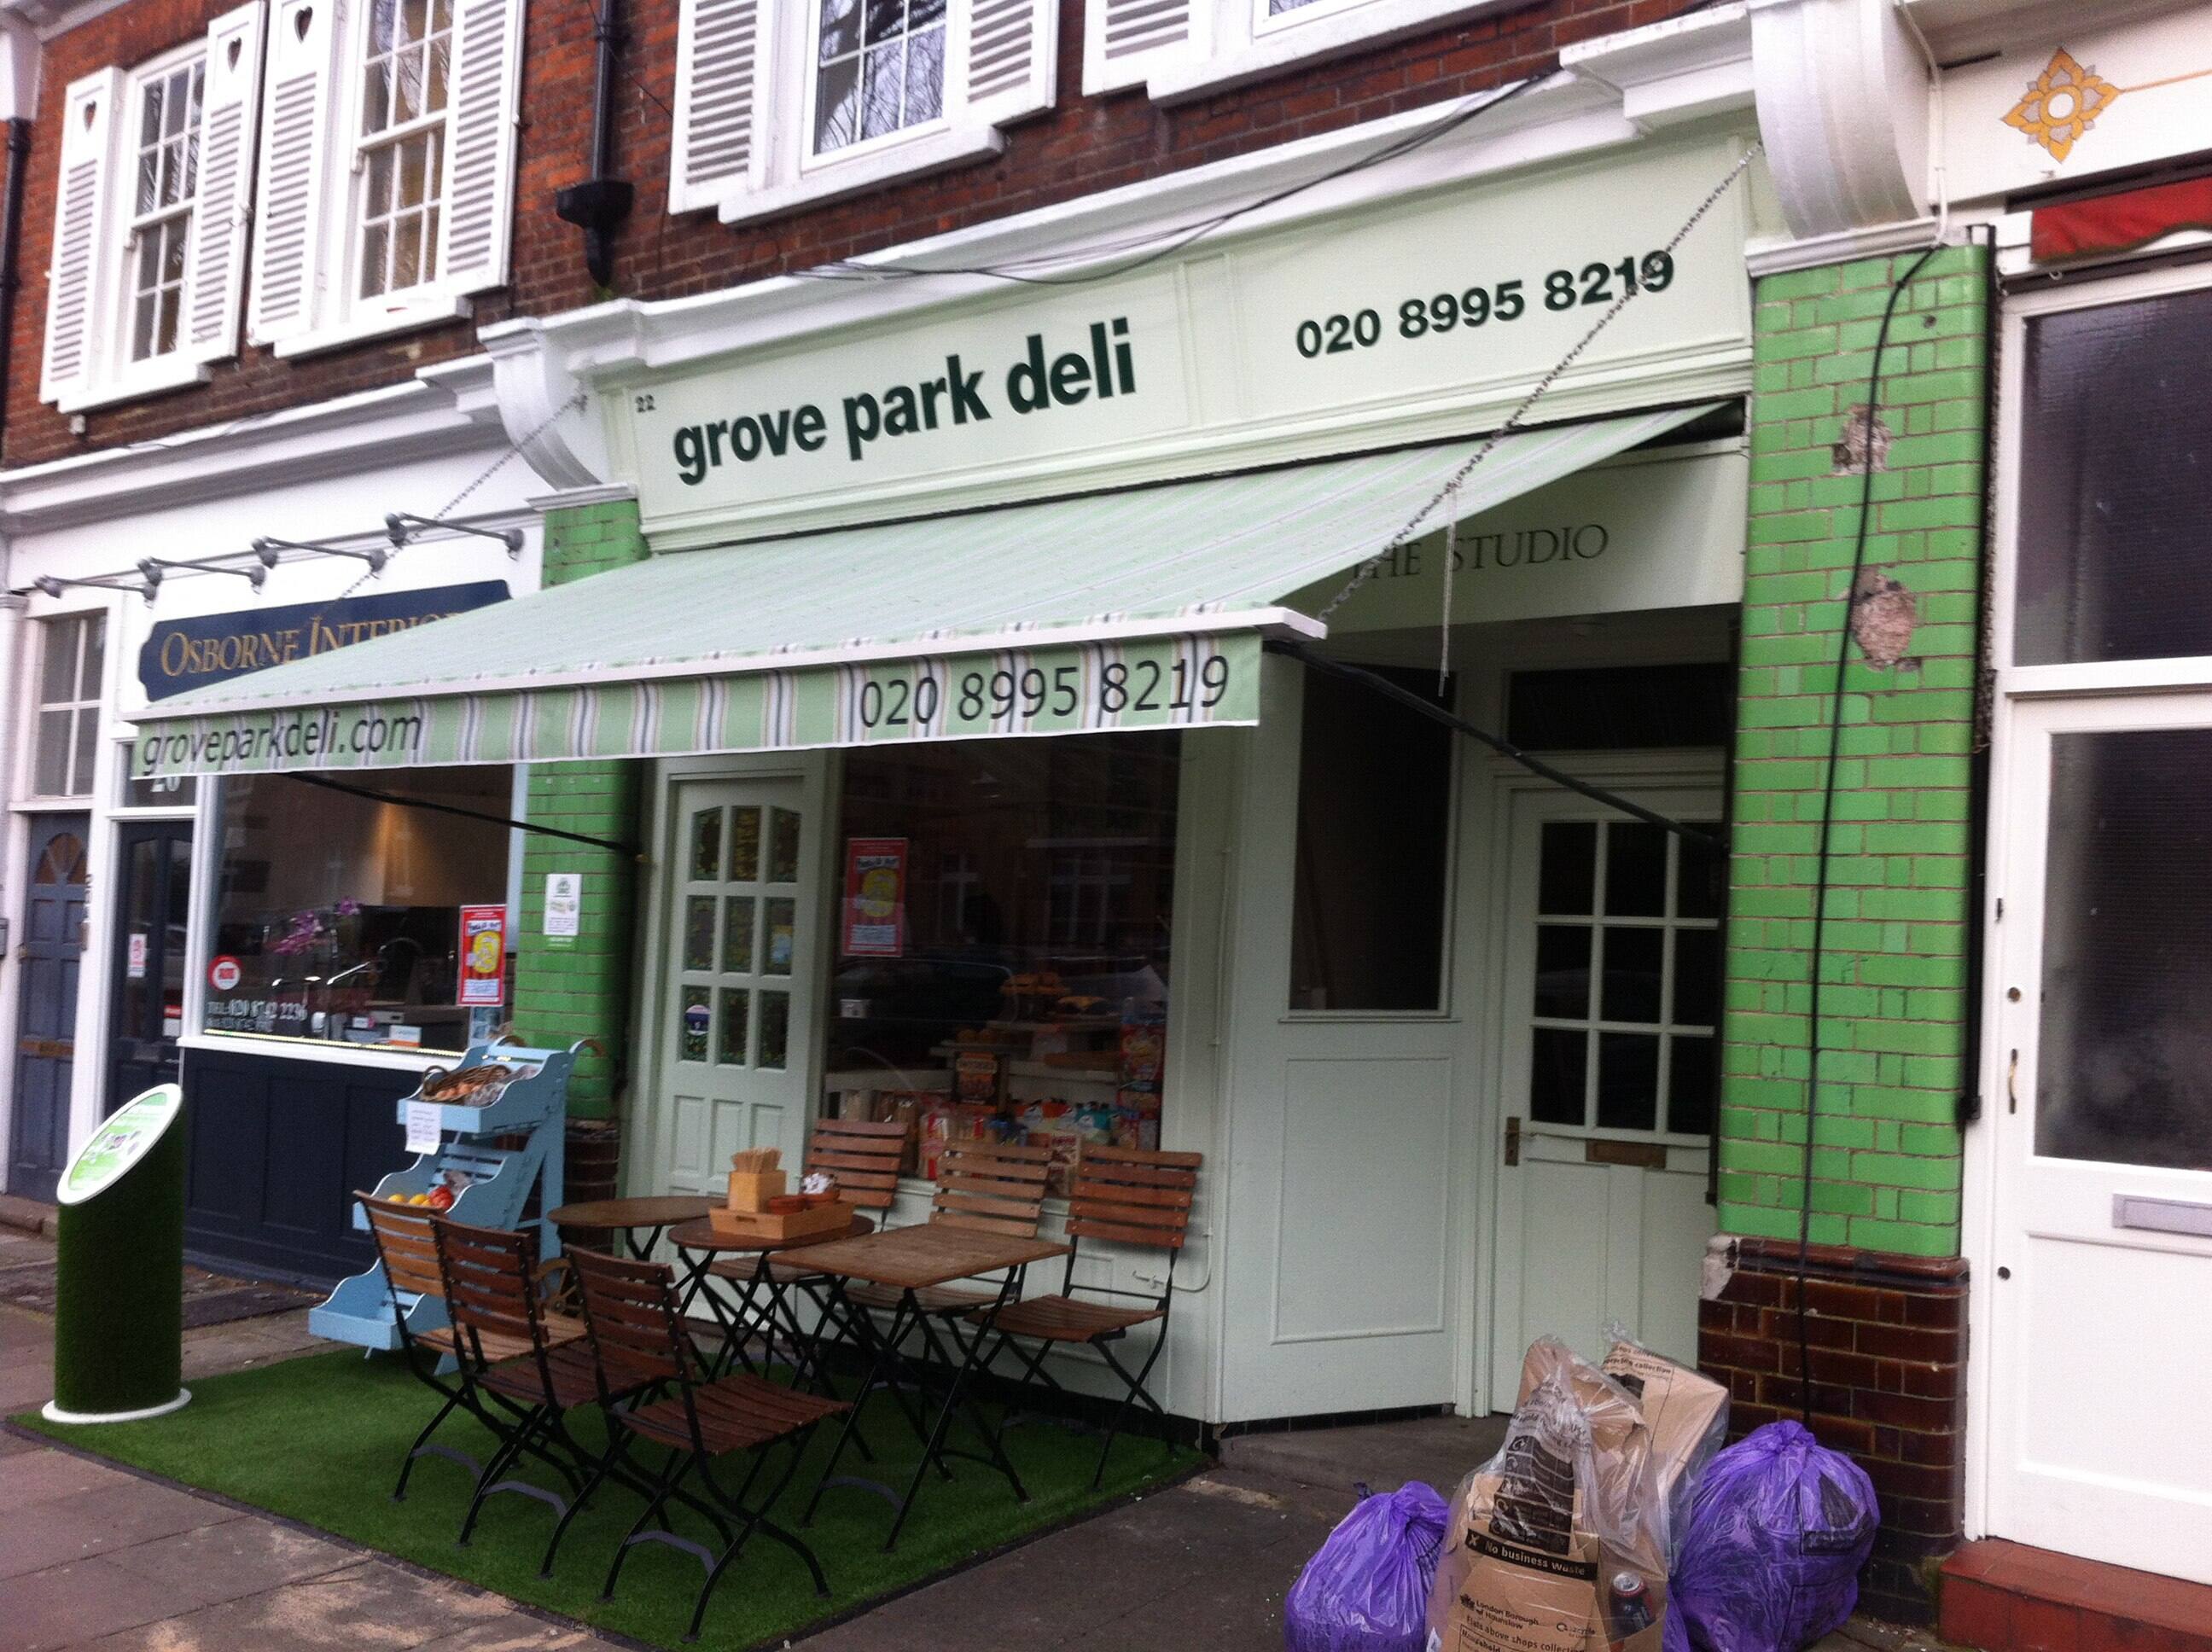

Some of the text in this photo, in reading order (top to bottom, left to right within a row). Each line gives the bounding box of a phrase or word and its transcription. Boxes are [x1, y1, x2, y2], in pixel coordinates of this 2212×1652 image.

[1296, 249, 1674, 358] 020 8995 8219
[636, 395, 656, 413] 22
[672, 317, 1136, 486] grove park deli
[1448, 524, 1610, 573] STUDIO
[161, 629, 300, 678] OSBORNE
[860, 655, 1229, 728] 020 8995 8219
[143, 707, 422, 776] groveparkdeli.com
[1485, 1539, 1499, 1554] No
[1501, 1546, 1549, 1568] business
[1476, 1600, 1540, 1626] London Borough
[1485, 1626, 1510, 1642] above
[1511, 1635, 1538, 1650] shops
